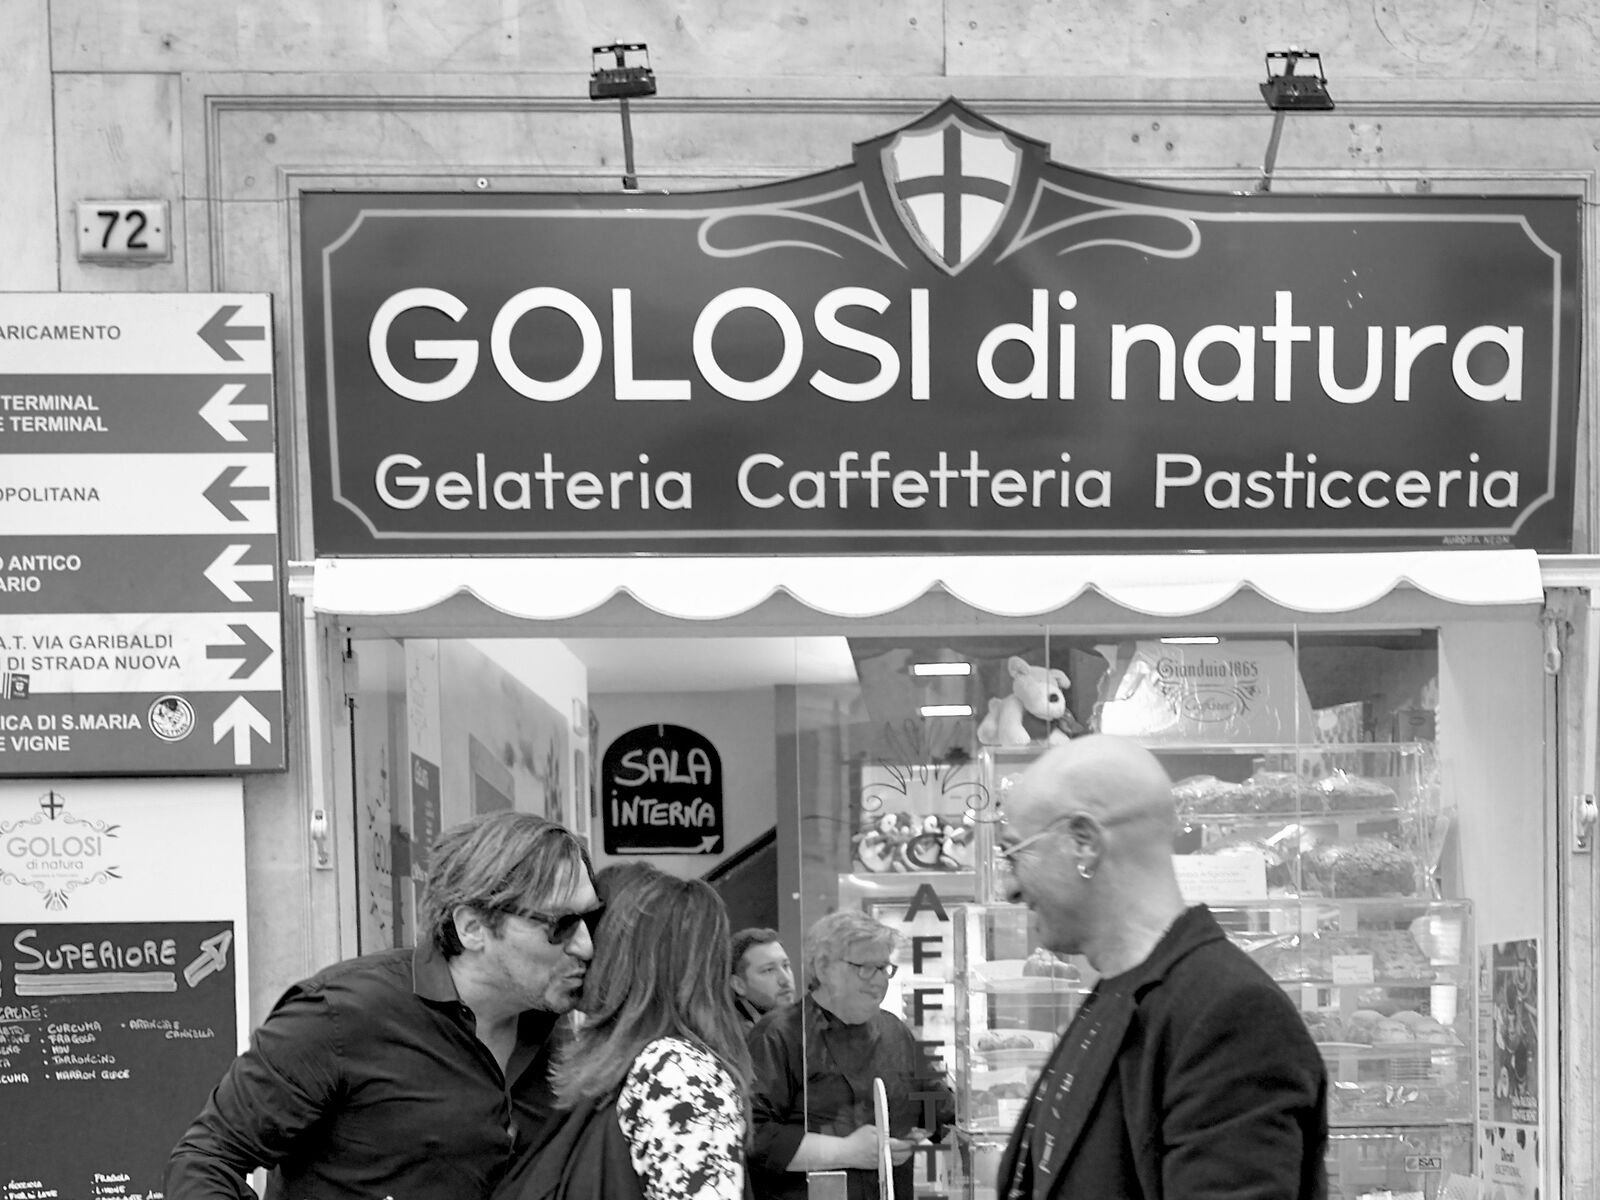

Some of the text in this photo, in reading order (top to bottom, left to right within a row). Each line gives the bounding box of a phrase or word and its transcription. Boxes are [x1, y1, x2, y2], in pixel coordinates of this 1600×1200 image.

[97, 210, 148, 249] 72
[370, 287, 1523, 403] GOLOSI di natura
[1, 394, 99, 411] TERMINAL
[10, 415, 108, 432] TERMINAL
[376, 451, 1518, 509] Gelateria Caffetteria Pasticceria
[8, 554, 81, 571] ANTICO
[32, 635, 63, 650] VIA
[69, 633, 173, 650] GARIBALDI
[7, 655, 181, 671] DI STRADA NUOVA
[37, 714, 56, 731] DI
[61, 713, 141, 730] S.MARIA
[11, 735, 70, 751] VIGNE
[613, 747, 711, 787] SALA
[7, 836, 101, 858] GOLOSI
[26, 859, 84, 870] di natura
[47, 1021, 101, 1034] CURCUMA
